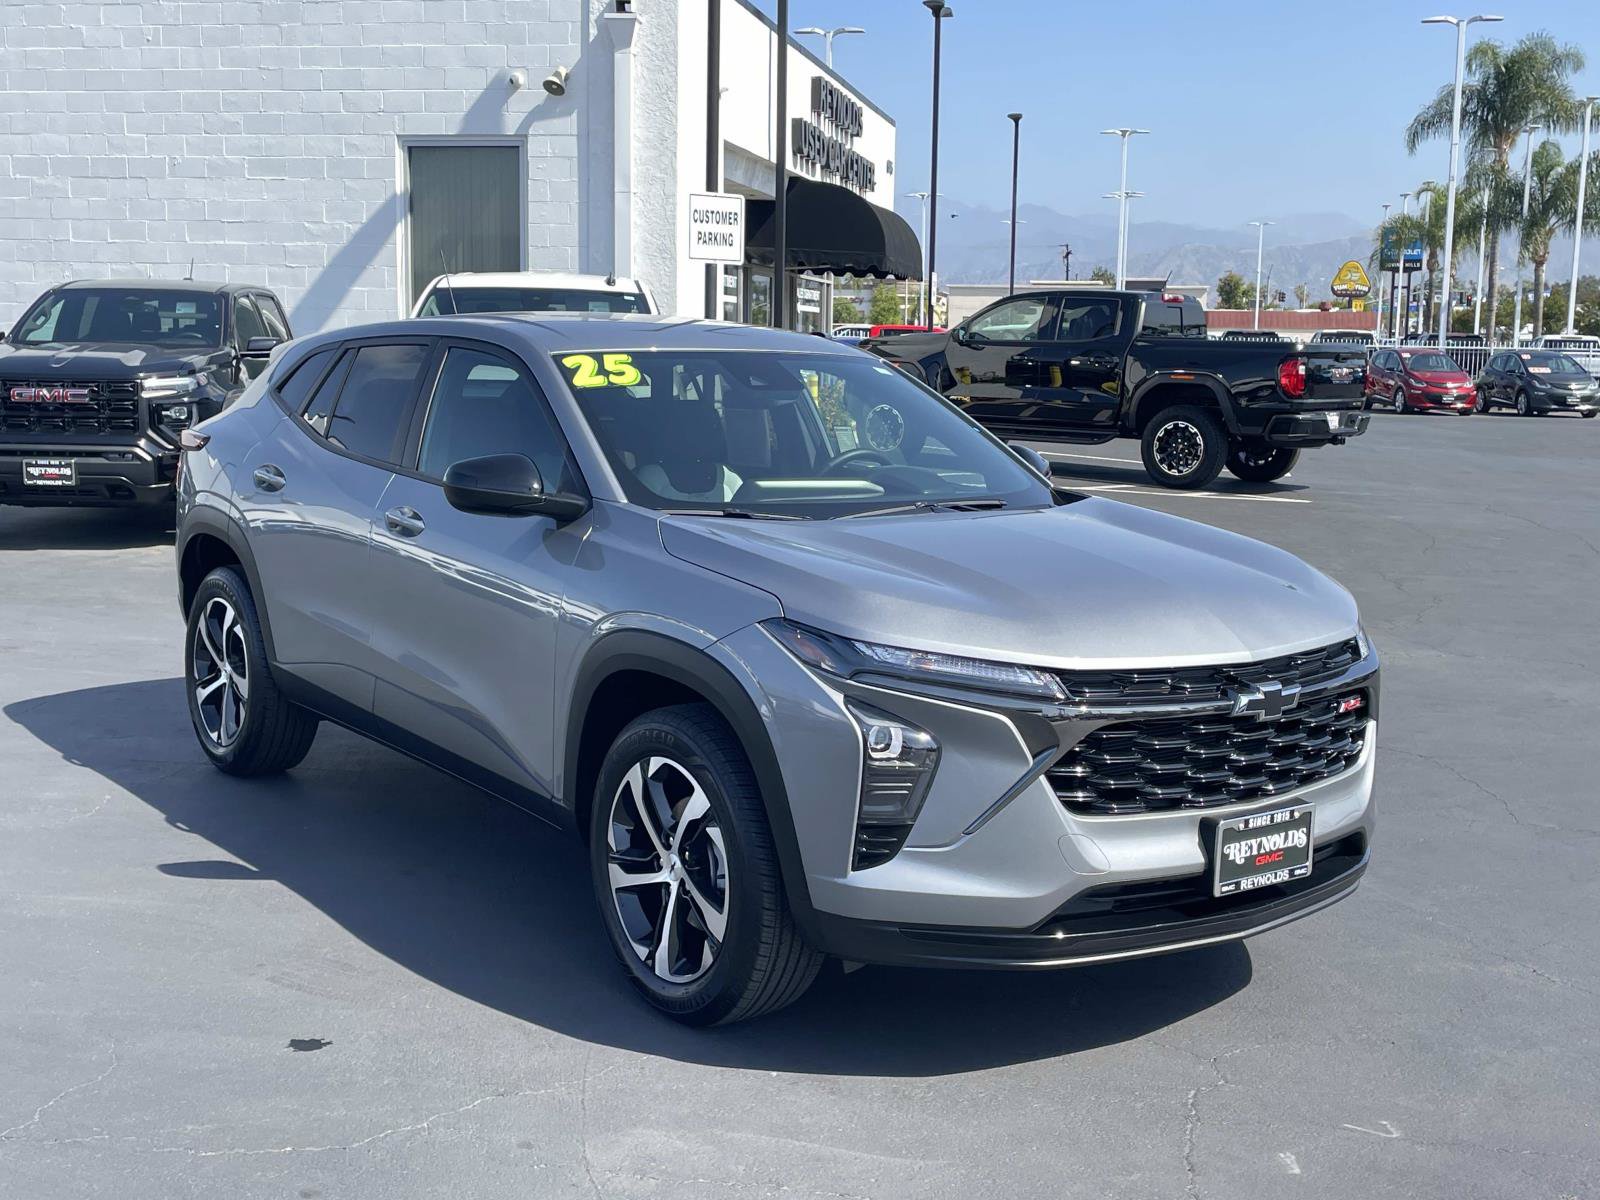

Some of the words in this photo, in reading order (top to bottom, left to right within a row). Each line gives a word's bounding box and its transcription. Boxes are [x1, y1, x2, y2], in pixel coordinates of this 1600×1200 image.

[811, 76, 863, 137] REYNOLDS
[792, 118, 828, 167] USED
[827, 136, 847, 180] CAR
[846, 149, 875, 192] CENTER
[692, 208, 739, 226] CUSTOMER
[697, 230, 734, 247] PARKING
[561, 353, 641, 388] 25
[10, 387, 90, 403] GMC
[27, 466, 72, 476] REYNOLDS
[1248, 814, 1271, 828] SINCE
[1223, 827, 1307, 865] REYNOLDS
[1255, 850, 1284, 866] GMC
[1240, 869, 1290, 890] REYNOLDS
